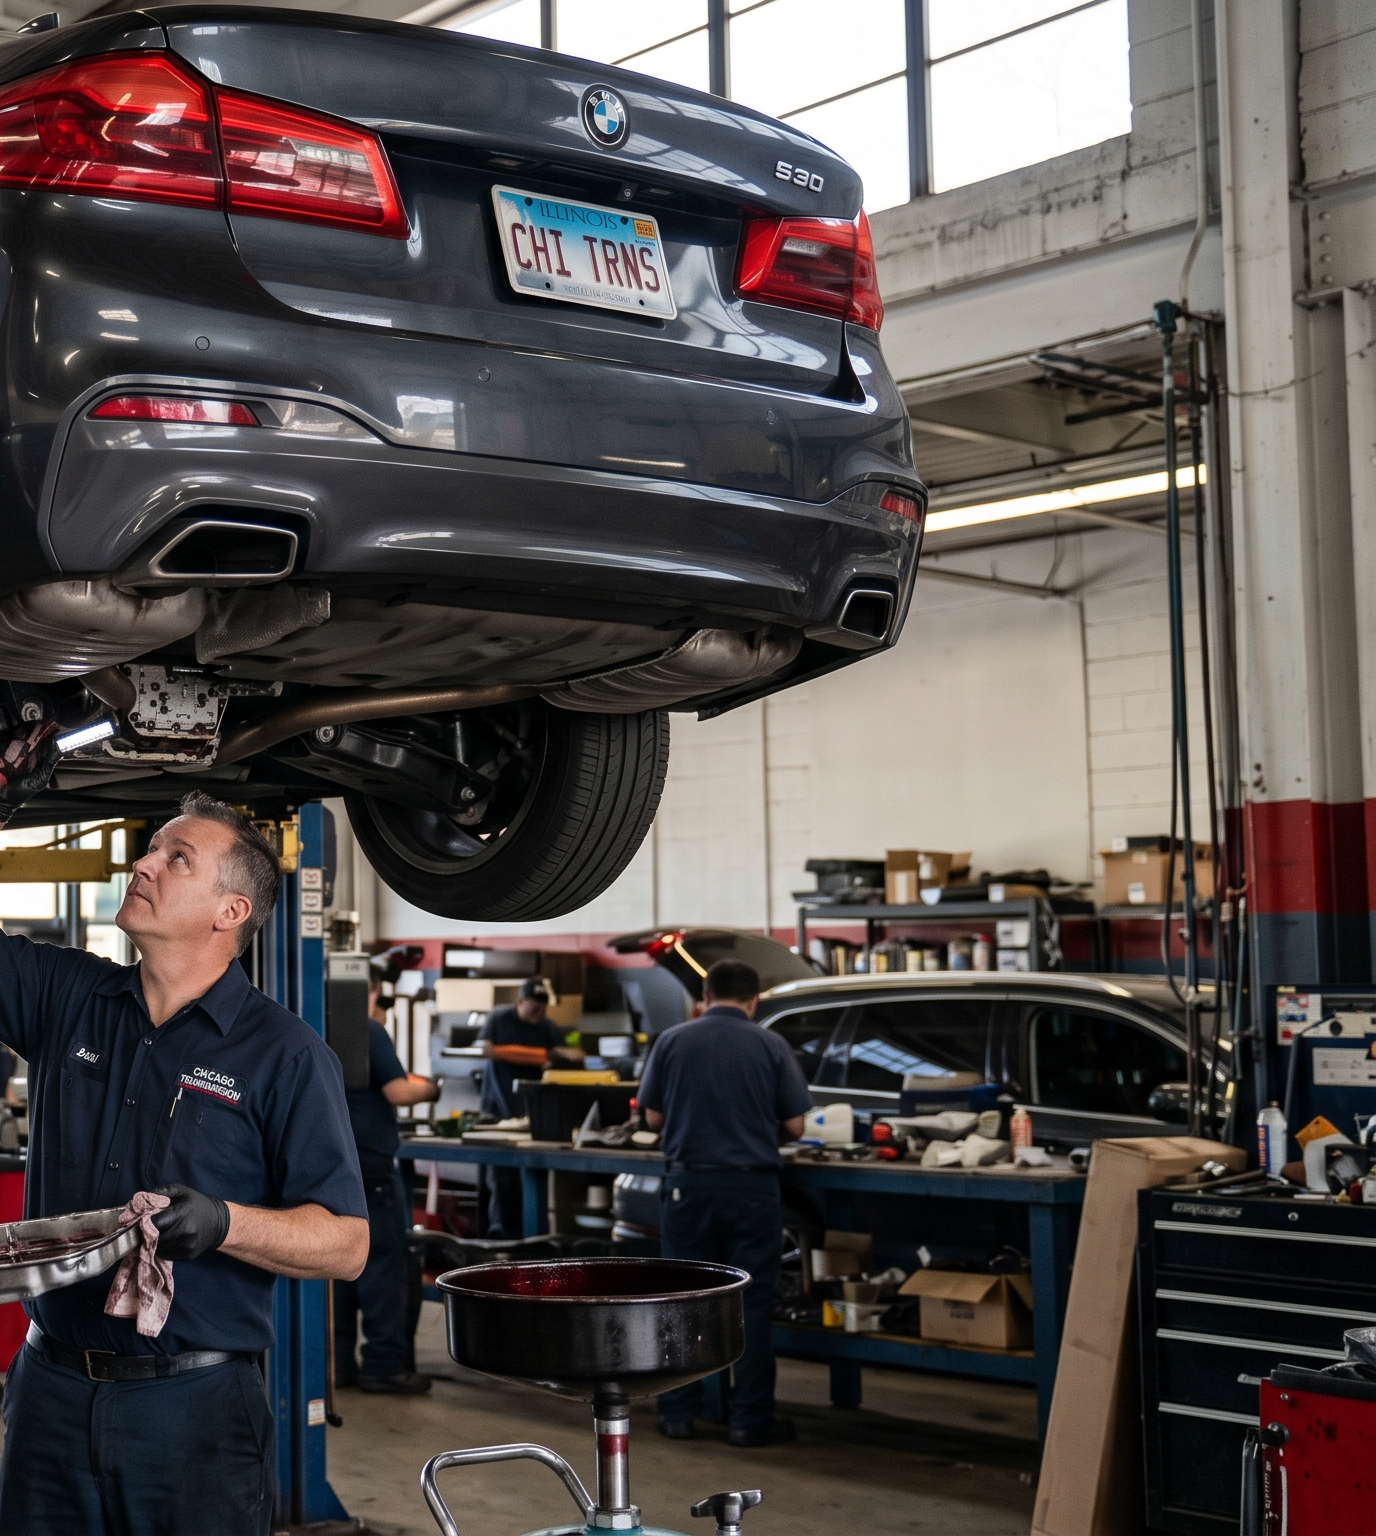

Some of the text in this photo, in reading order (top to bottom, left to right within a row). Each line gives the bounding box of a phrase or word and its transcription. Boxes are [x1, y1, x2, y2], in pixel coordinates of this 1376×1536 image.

[775, 160, 824, 193] 530
[539, 202, 618, 230] ILLINOIS
[511, 222, 661, 294] CHI TRNS
